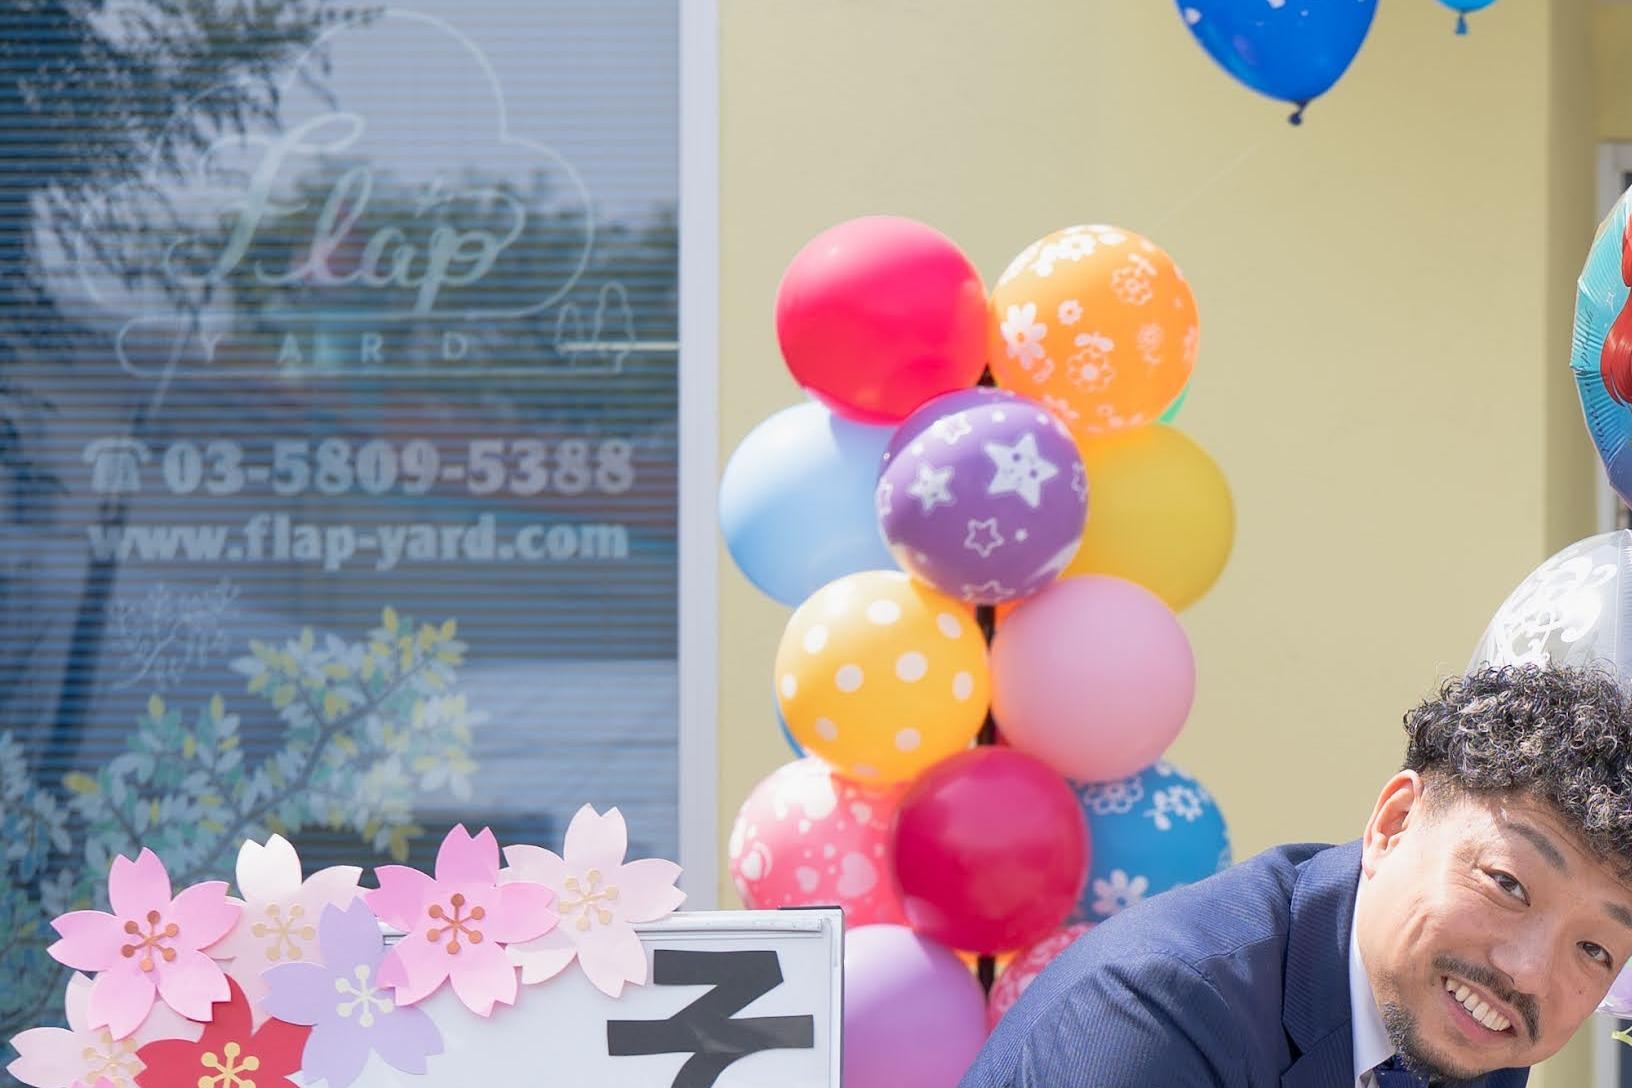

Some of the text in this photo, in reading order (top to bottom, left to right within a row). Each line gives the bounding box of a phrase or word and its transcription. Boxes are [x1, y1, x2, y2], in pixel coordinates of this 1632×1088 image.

[202, 333, 468, 361] YARD
[164, 440, 634, 495] 03-5809-5388
[92, 514, 628, 569] www.flap-yard.com
